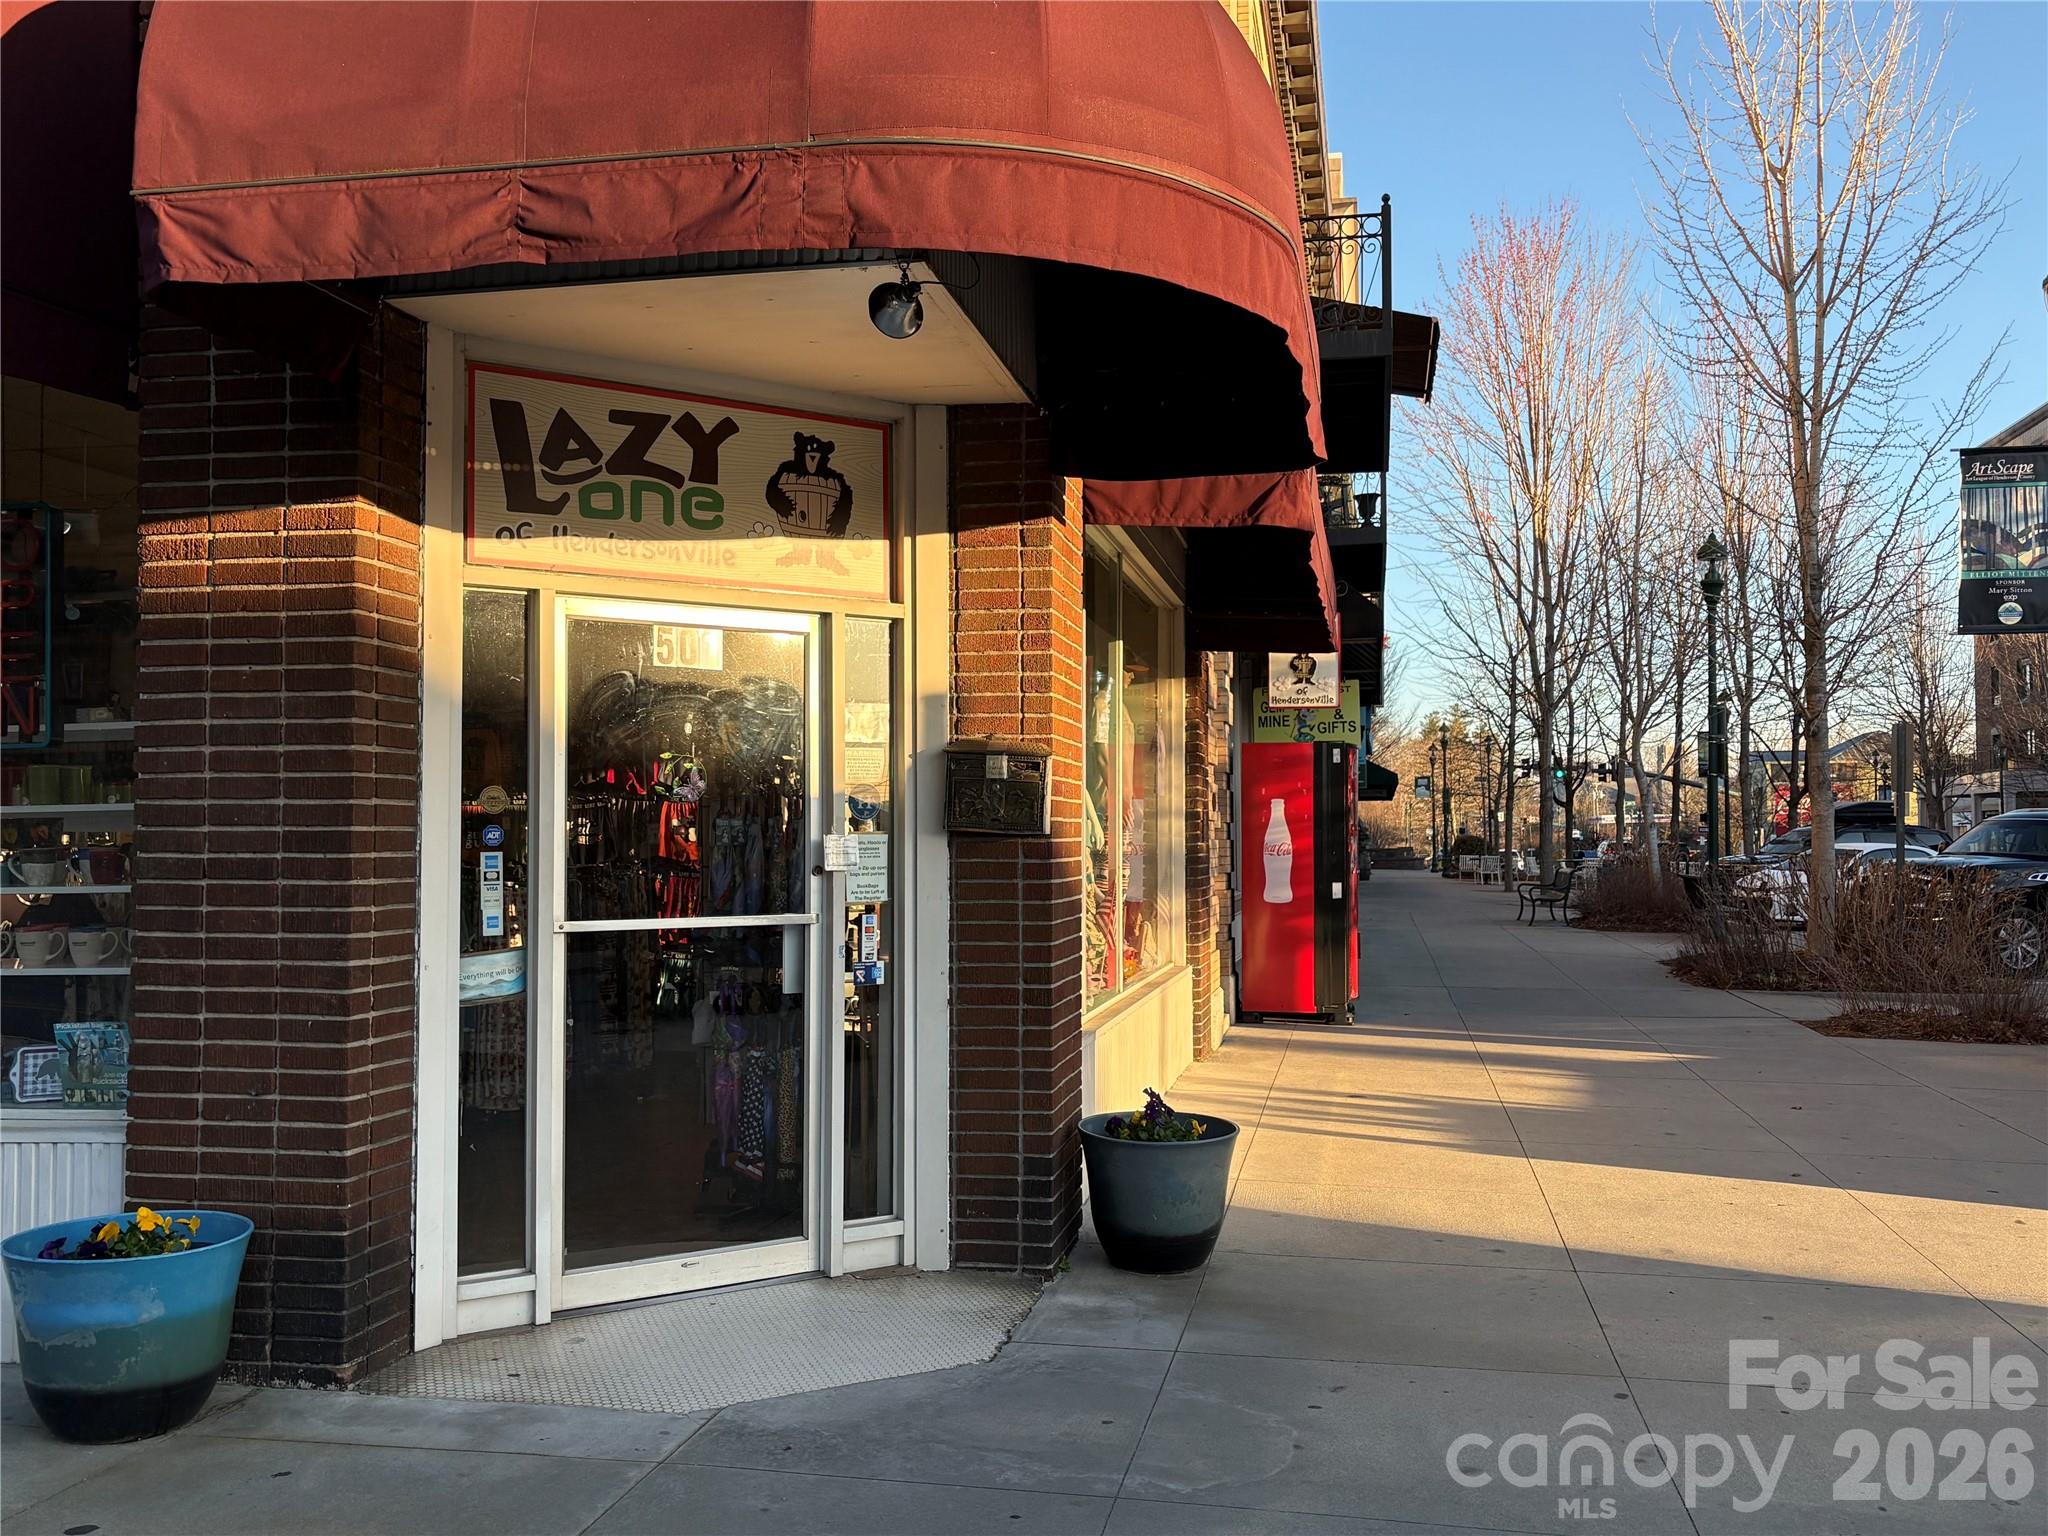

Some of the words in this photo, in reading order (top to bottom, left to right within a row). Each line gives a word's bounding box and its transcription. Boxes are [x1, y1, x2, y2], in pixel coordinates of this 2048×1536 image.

[489, 397, 740, 516] LAZY
[578, 478, 725, 531] one
[495, 521, 535, 549] of
[551, 524, 738, 568] Hendersonville
[1988, 587, 2008, 595] Mary
[656, 626, 721, 667] 50
[1296, 686, 1308, 696] of
[1271, 694, 1335, 705] Hendersonville
[1333, 708, 1344, 720] &
[1258, 715, 1290, 728] MINE
[1317, 720, 1357, 734] GIFTS
[486, 831, 501, 840] ADT
[459, 970, 494, 981] Everything
[495, 968, 507, 976] will
